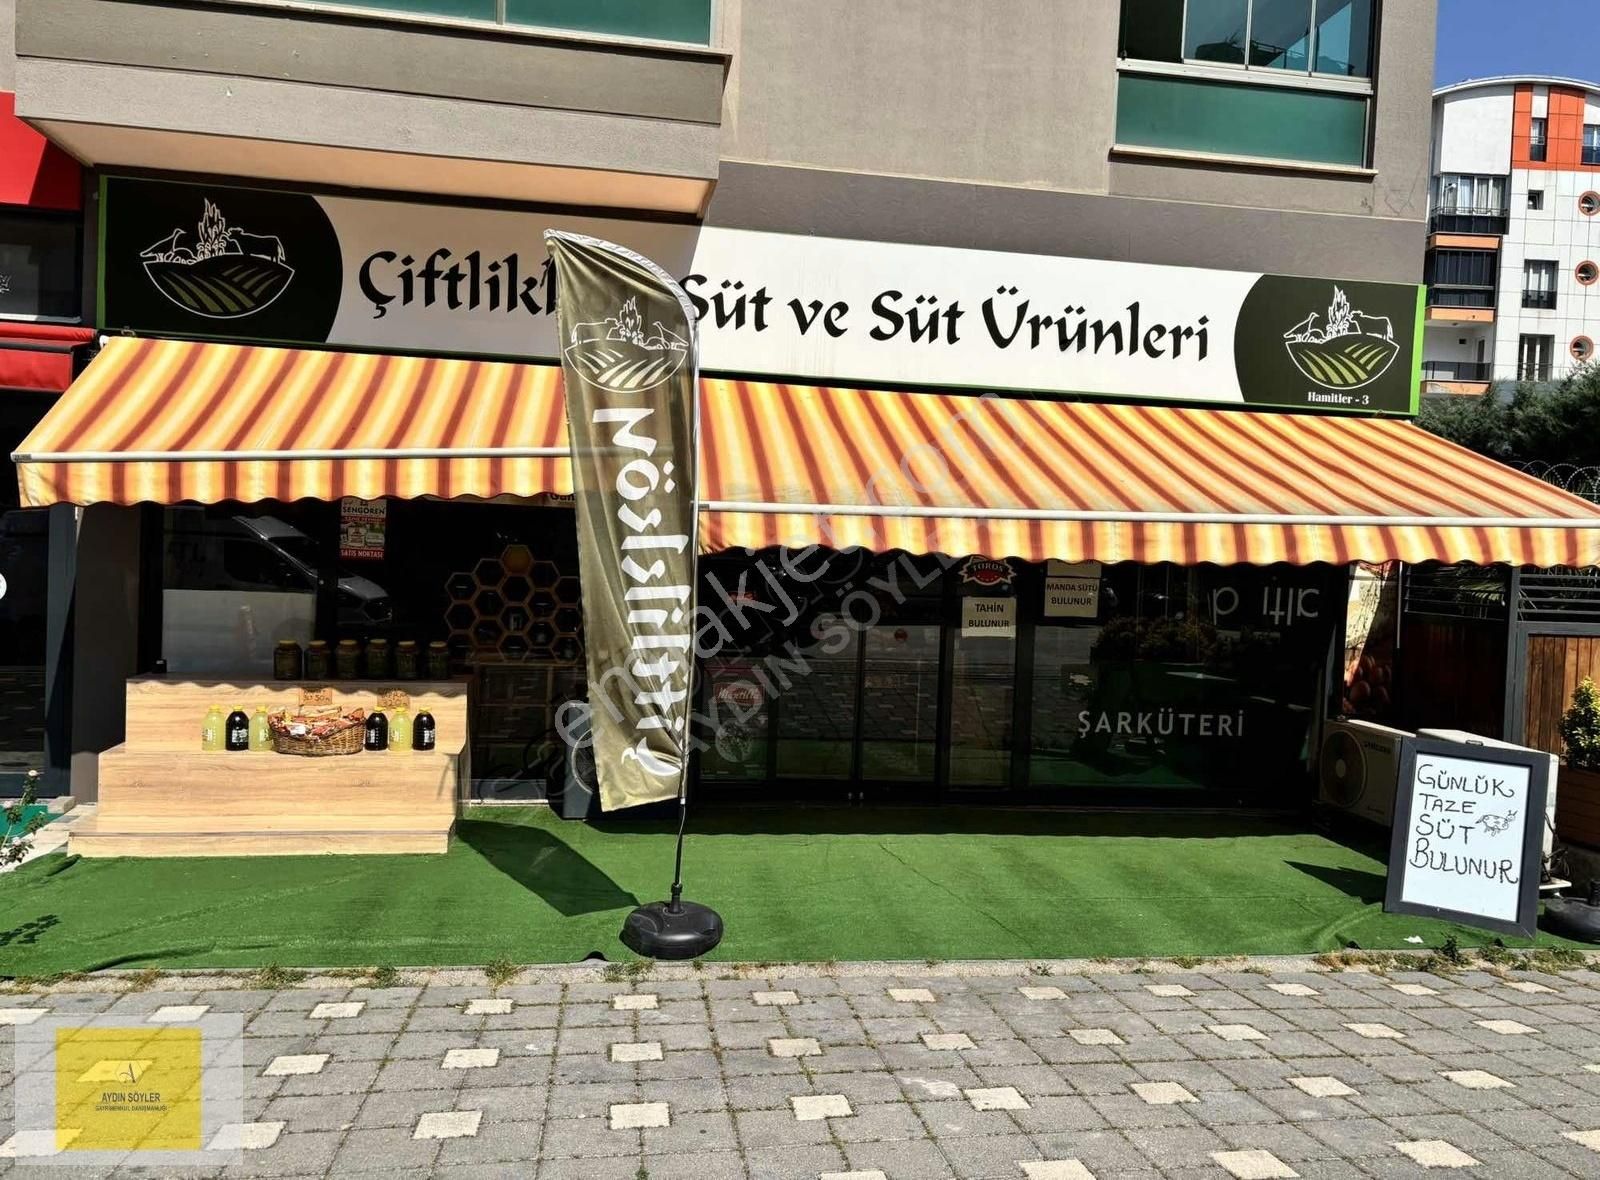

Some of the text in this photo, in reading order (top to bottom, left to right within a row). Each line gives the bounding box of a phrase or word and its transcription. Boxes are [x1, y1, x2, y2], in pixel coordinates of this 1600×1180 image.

[679, 274, 774, 332] Süt
[787, 298, 849, 336] ve
[869, 290, 966, 345] Süt
[981, 285, 1210, 361] Ürünleri
[1307, 391, 1353, 404] Hamitler
[1361, 394, 1370, 405] 3
[1046, 583, 1076, 592] MANDA
[975, 601, 1004, 613] TAHİN
[1050, 596, 1092, 606] BULUNUR
[968, 619, 1010, 628] BULUNUR
[1077, 708, 1244, 738] ŞARKÜTERİ
[1417, 763, 1515, 798] GÜNLÜK
[1418, 792, 1477, 814] TAZE
[1415, 813, 1475, 845] SÜT
[1408, 837, 1519, 885] BULUNUR
